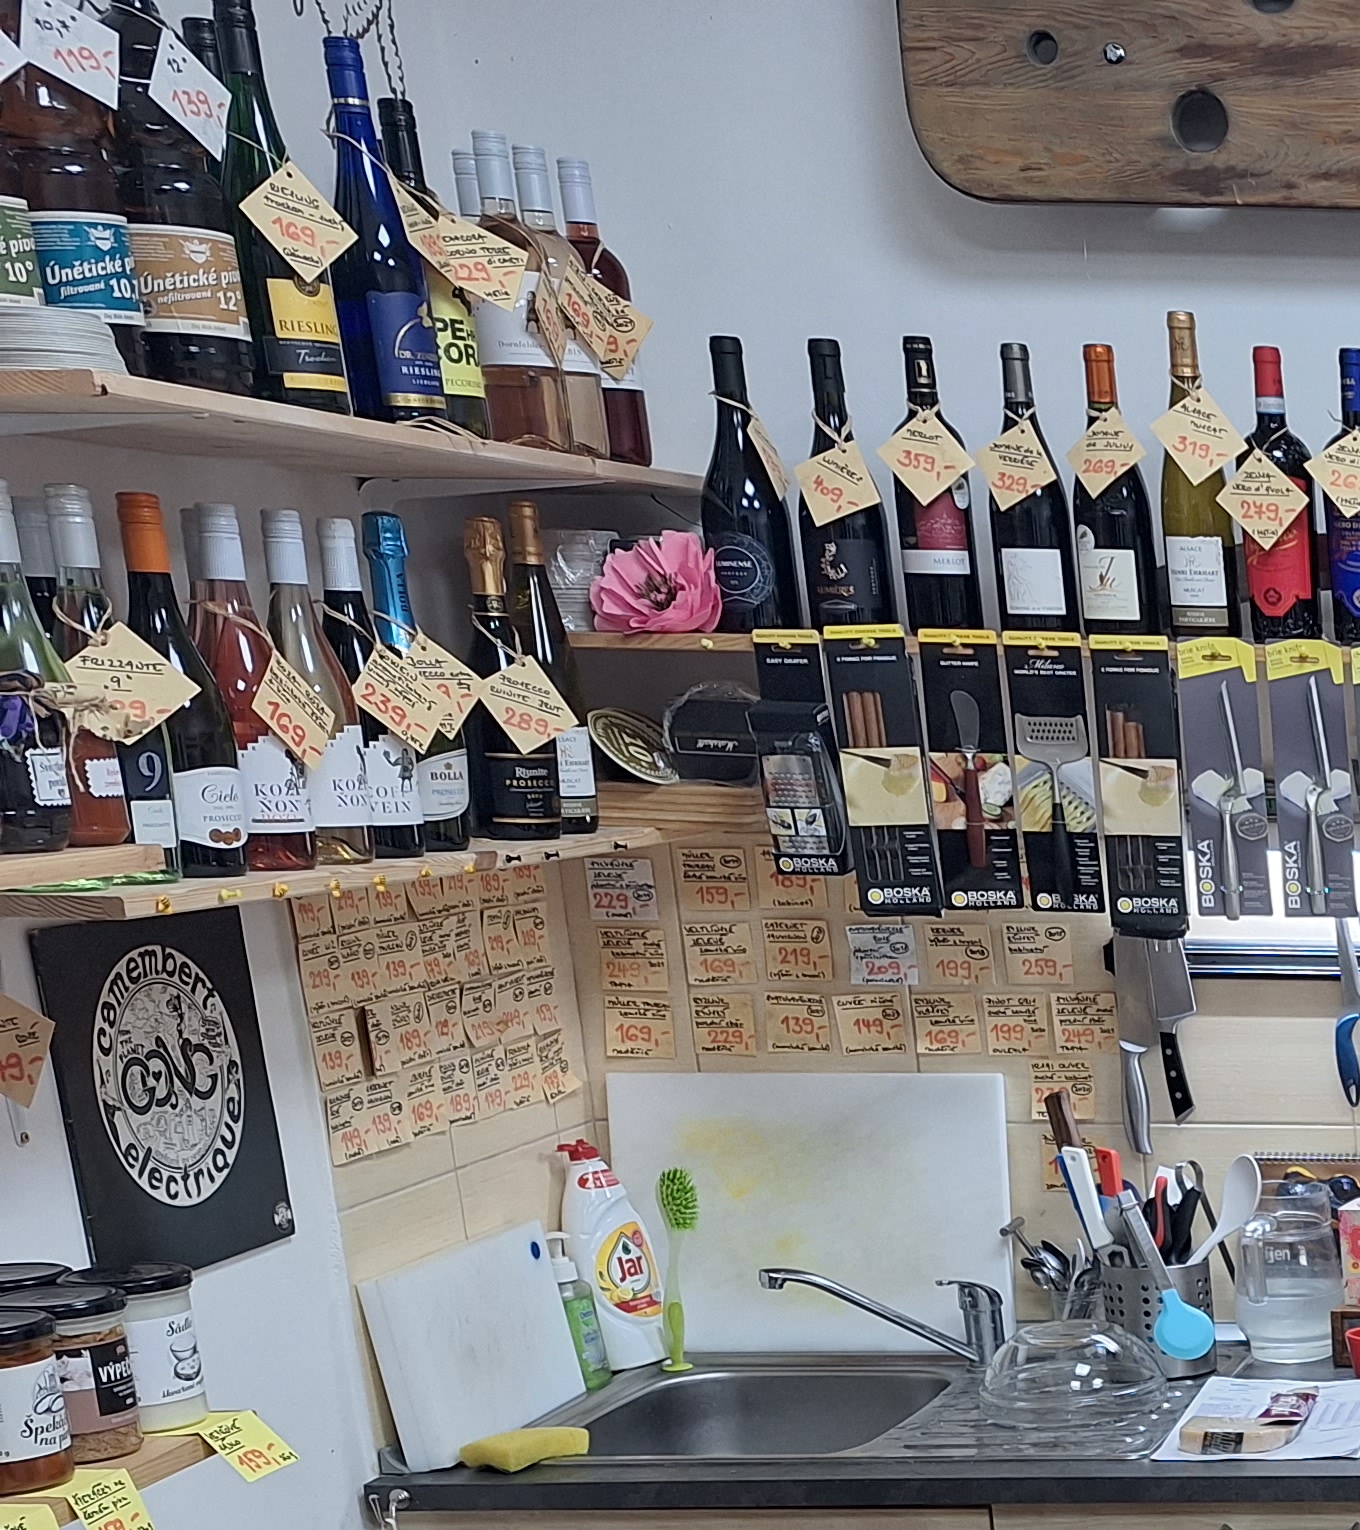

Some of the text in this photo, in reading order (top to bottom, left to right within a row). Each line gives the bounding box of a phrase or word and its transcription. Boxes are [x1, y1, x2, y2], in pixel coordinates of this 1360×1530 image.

[896, 449, 957, 482] 359,-
[429, 769, 464, 782] BOLLA
[791, 857, 837, 869] BOSKA
[1196, 840, 1215, 909] BOSKA
[1285, 841, 1301, 910] BOSKA
[883, 887, 931, 900] BOSKA
[967, 890, 1017, 902] BOSKA
[1131, 896, 1179, 909] BOSKA
[100, 946, 217, 1057] camembert
[617, 1254, 643, 1283] Jar
